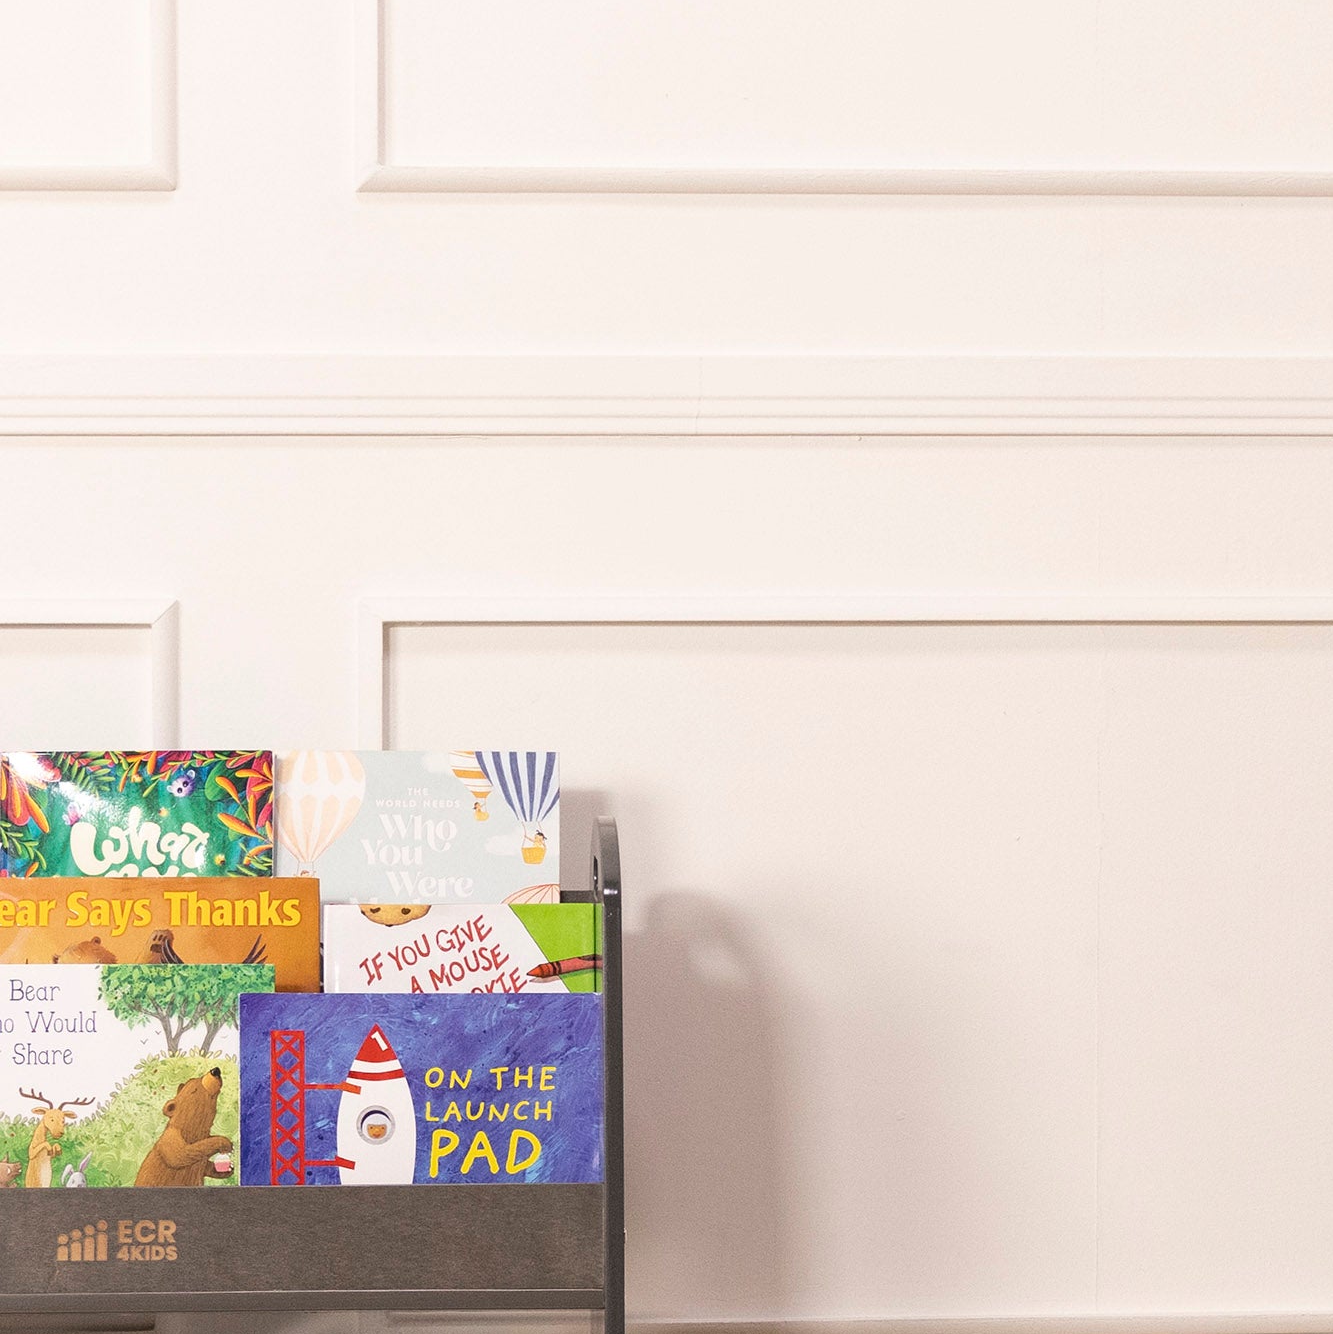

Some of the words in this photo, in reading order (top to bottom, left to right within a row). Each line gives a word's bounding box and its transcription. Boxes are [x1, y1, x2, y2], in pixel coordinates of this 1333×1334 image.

[376, 799, 416, 808] WORLD
[423, 799, 461, 808] NEEDS
[407, 787, 429, 796] THE
[70, 806, 209, 875] What
[379, 814, 457, 851] Who
[361, 839, 424, 866] You
[387, 871, 474, 898] Were
[66, 891, 151, 936] Says
[164, 891, 301, 927] Thanks
[359, 952, 383, 986] IF
[387, 934, 431, 971] YOU
[436, 915, 493, 953] GIVE
[411, 976, 424, 993] A
[429, 944, 510, 991] MOUSE
[9, 979, 61, 1001] Bear
[25, 1011, 97, 1033] Would
[371, 1031, 389, 1052] 1
[12, 1043, 73, 1065] Share
[424, 1067, 473, 1090] ON
[489, 1066, 556, 1091] THE
[425, 1100, 553, 1123] LAUNCH
[429, 1128, 542, 1178] PAD
[117, 1219, 177, 1243] ECR
[116, 1245, 178, 1261] 4KIDS
